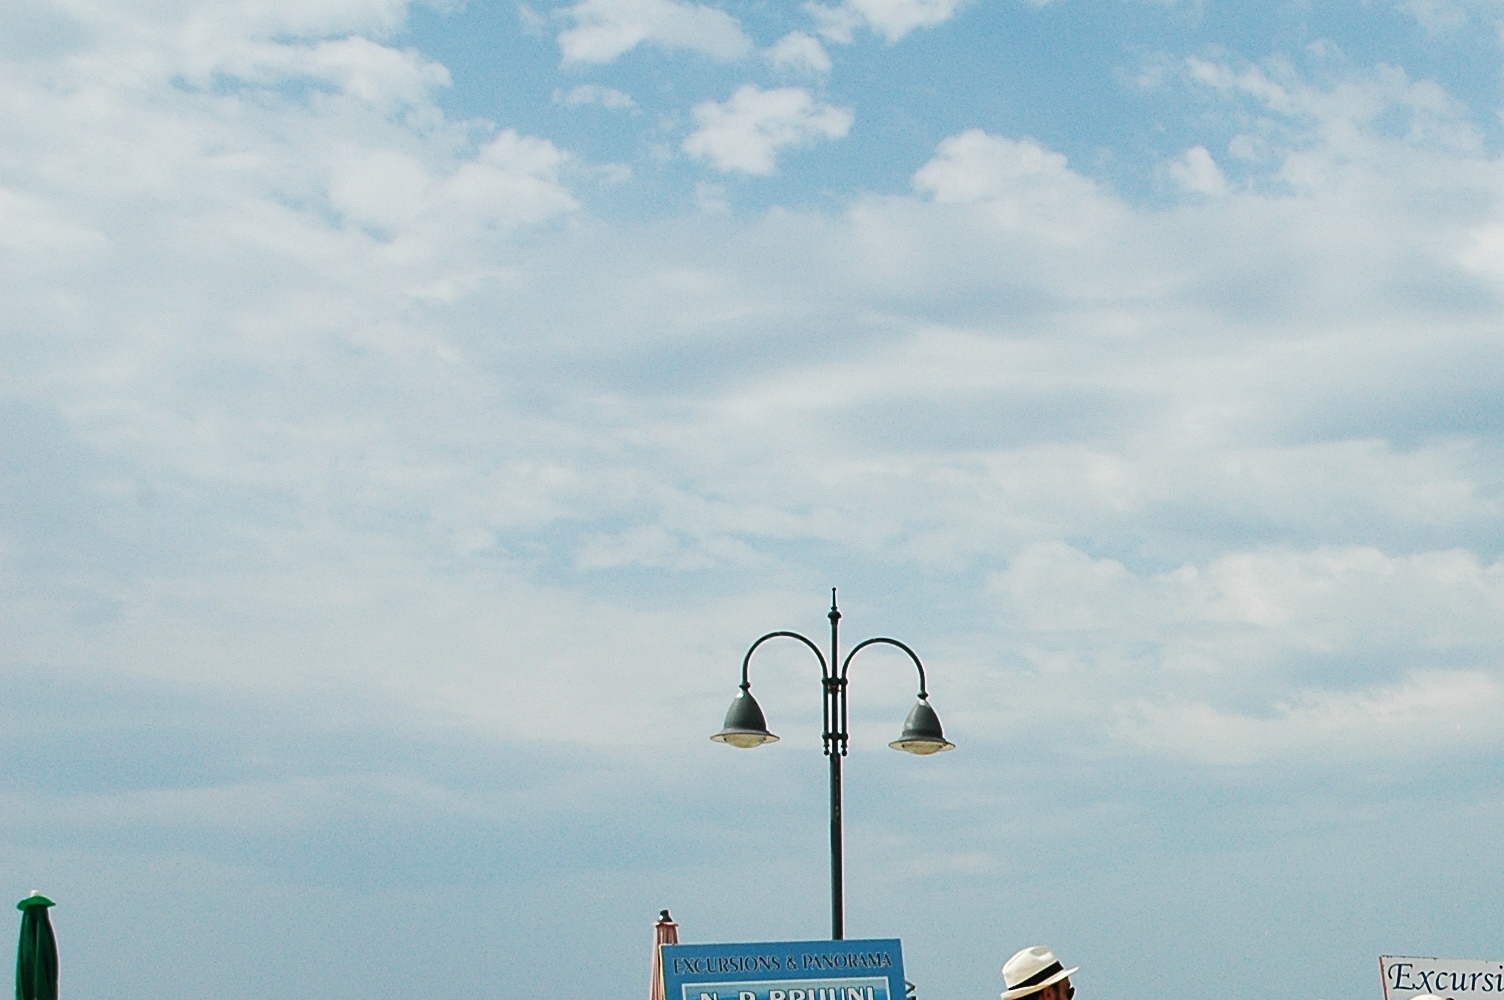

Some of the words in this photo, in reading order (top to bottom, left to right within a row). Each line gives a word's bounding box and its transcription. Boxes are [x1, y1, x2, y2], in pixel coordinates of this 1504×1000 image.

[673, 956, 781, 974] EXCURSIONS
[786, 955, 797, 970] &
[802, 952, 893, 970] PANORAMA
